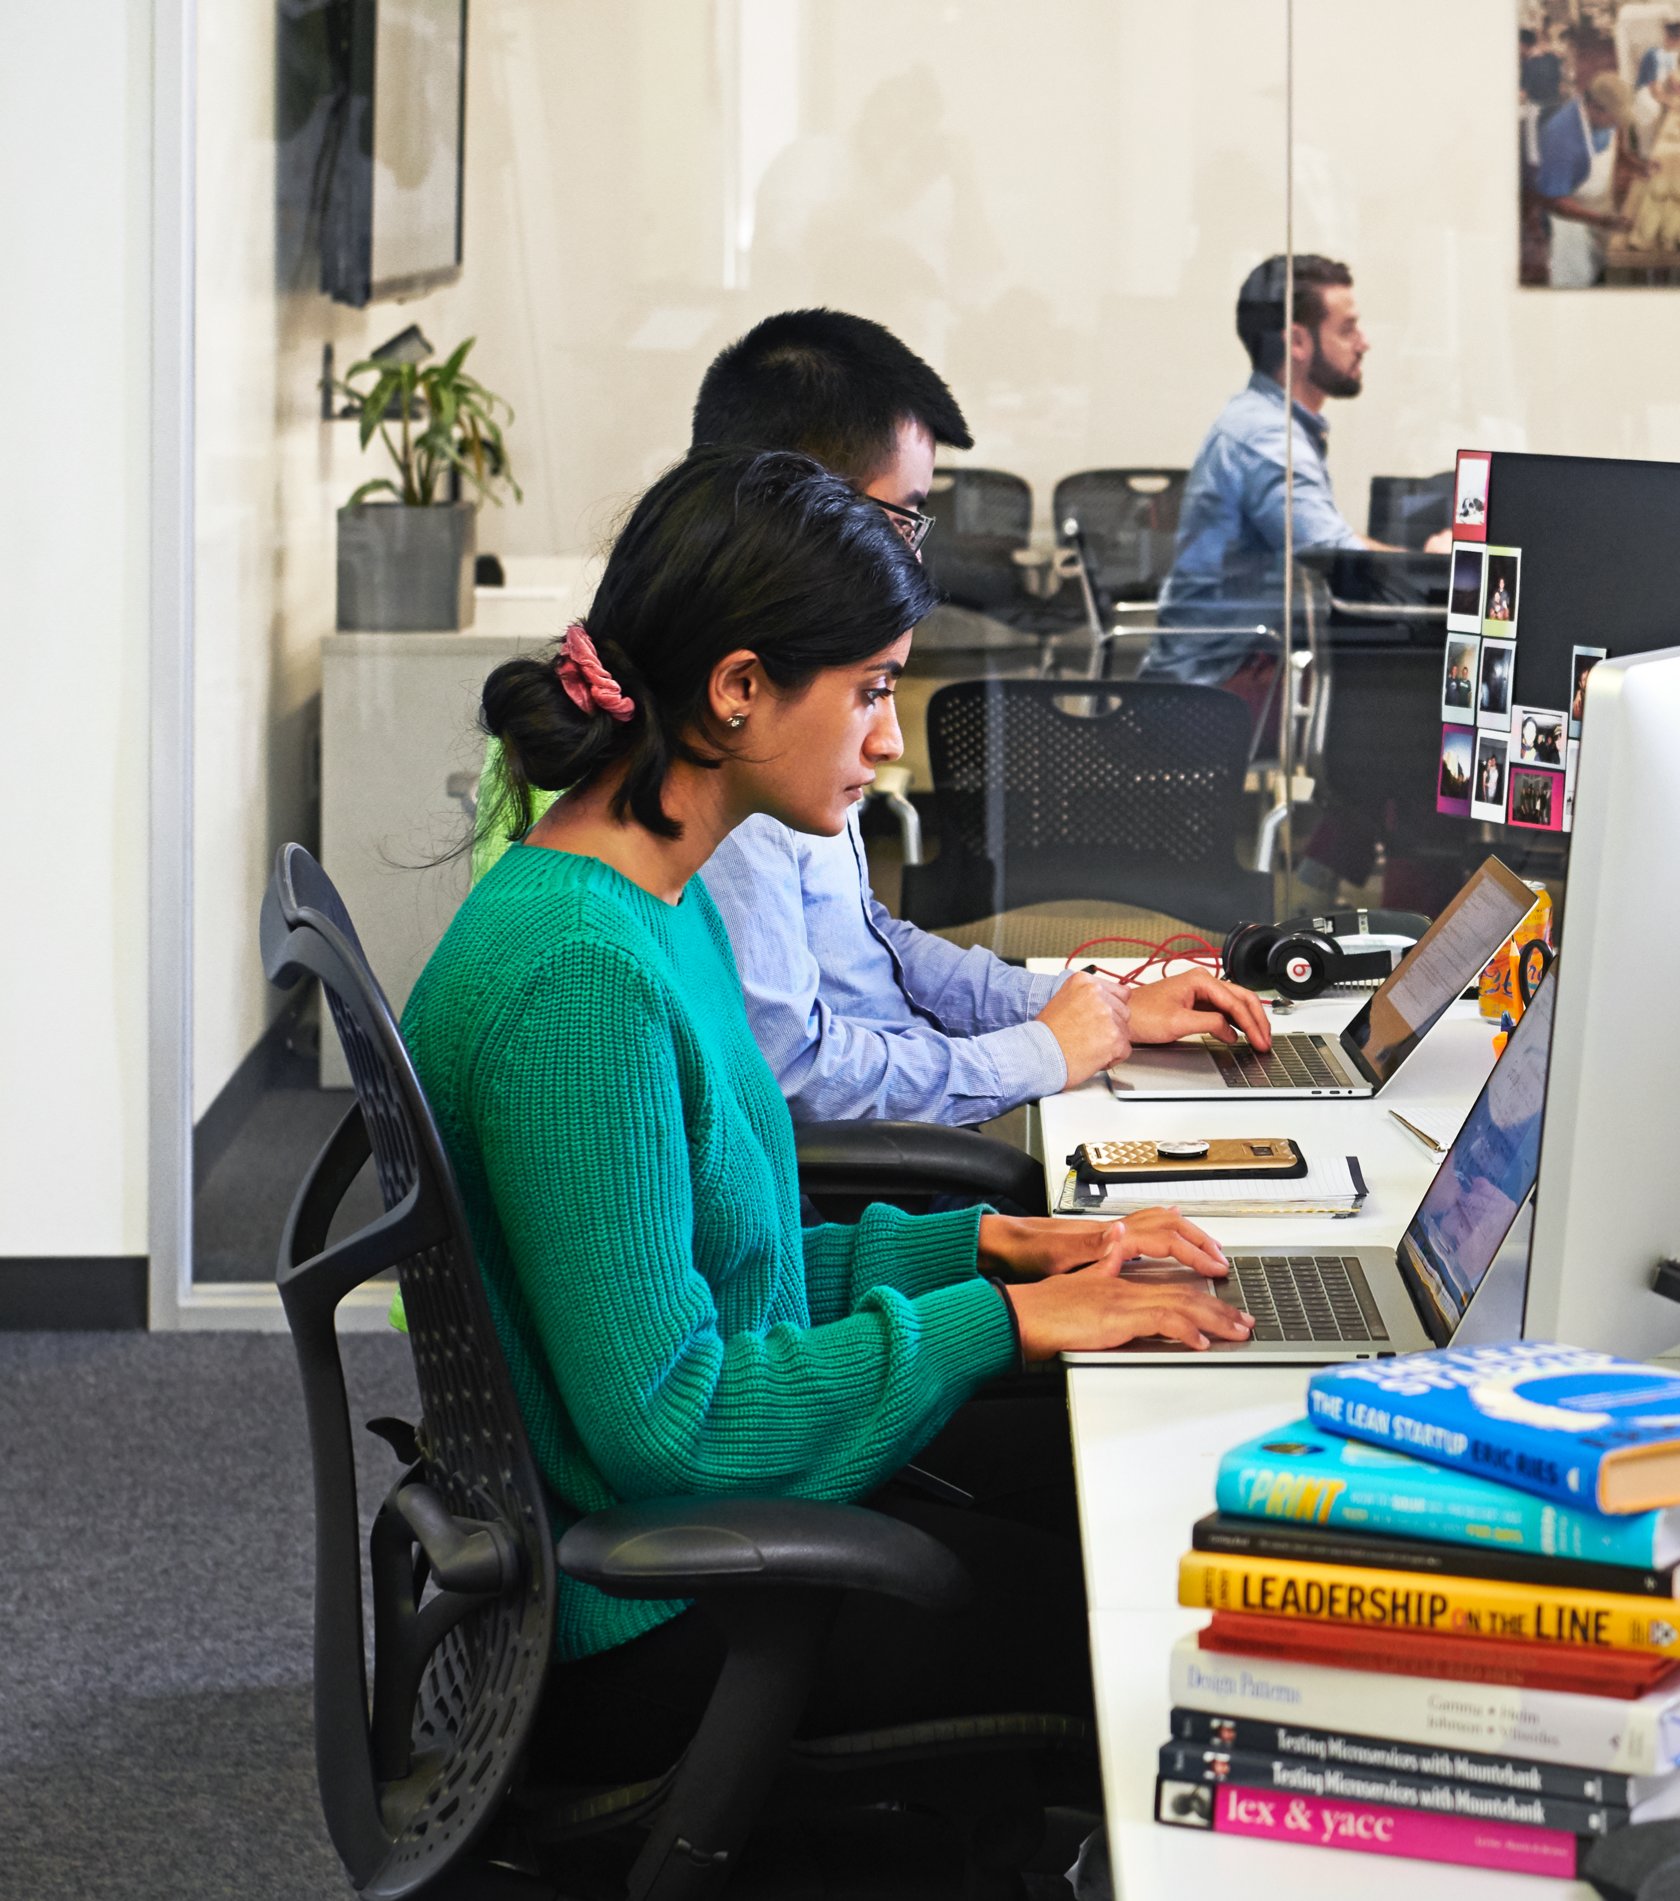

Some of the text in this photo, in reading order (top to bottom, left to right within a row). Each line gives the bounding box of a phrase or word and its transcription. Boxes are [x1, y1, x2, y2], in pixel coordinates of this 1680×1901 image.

[1310, 1389, 1559, 1485] THE LEAN STARTUP ERIC RIES
[1242, 1574, 1448, 1628] LEADERSHIP
[1452, 1606, 1481, 1633] ON
[1489, 1611, 1525, 1636] THE
[1535, 1603, 1611, 1646] LINE
[1186, 1664, 1301, 1704] Design Patterns
[1428, 1695, 1483, 1716] Gamma
[1428, 1714, 1483, 1735] Johnson
[1276, 1728, 1542, 1791] Testing Microservices with Mountebank
[1227, 1790, 1394, 1842] lex & yacc
[1272, 1761, 1545, 1824] Testing Microservices with Mountebank
